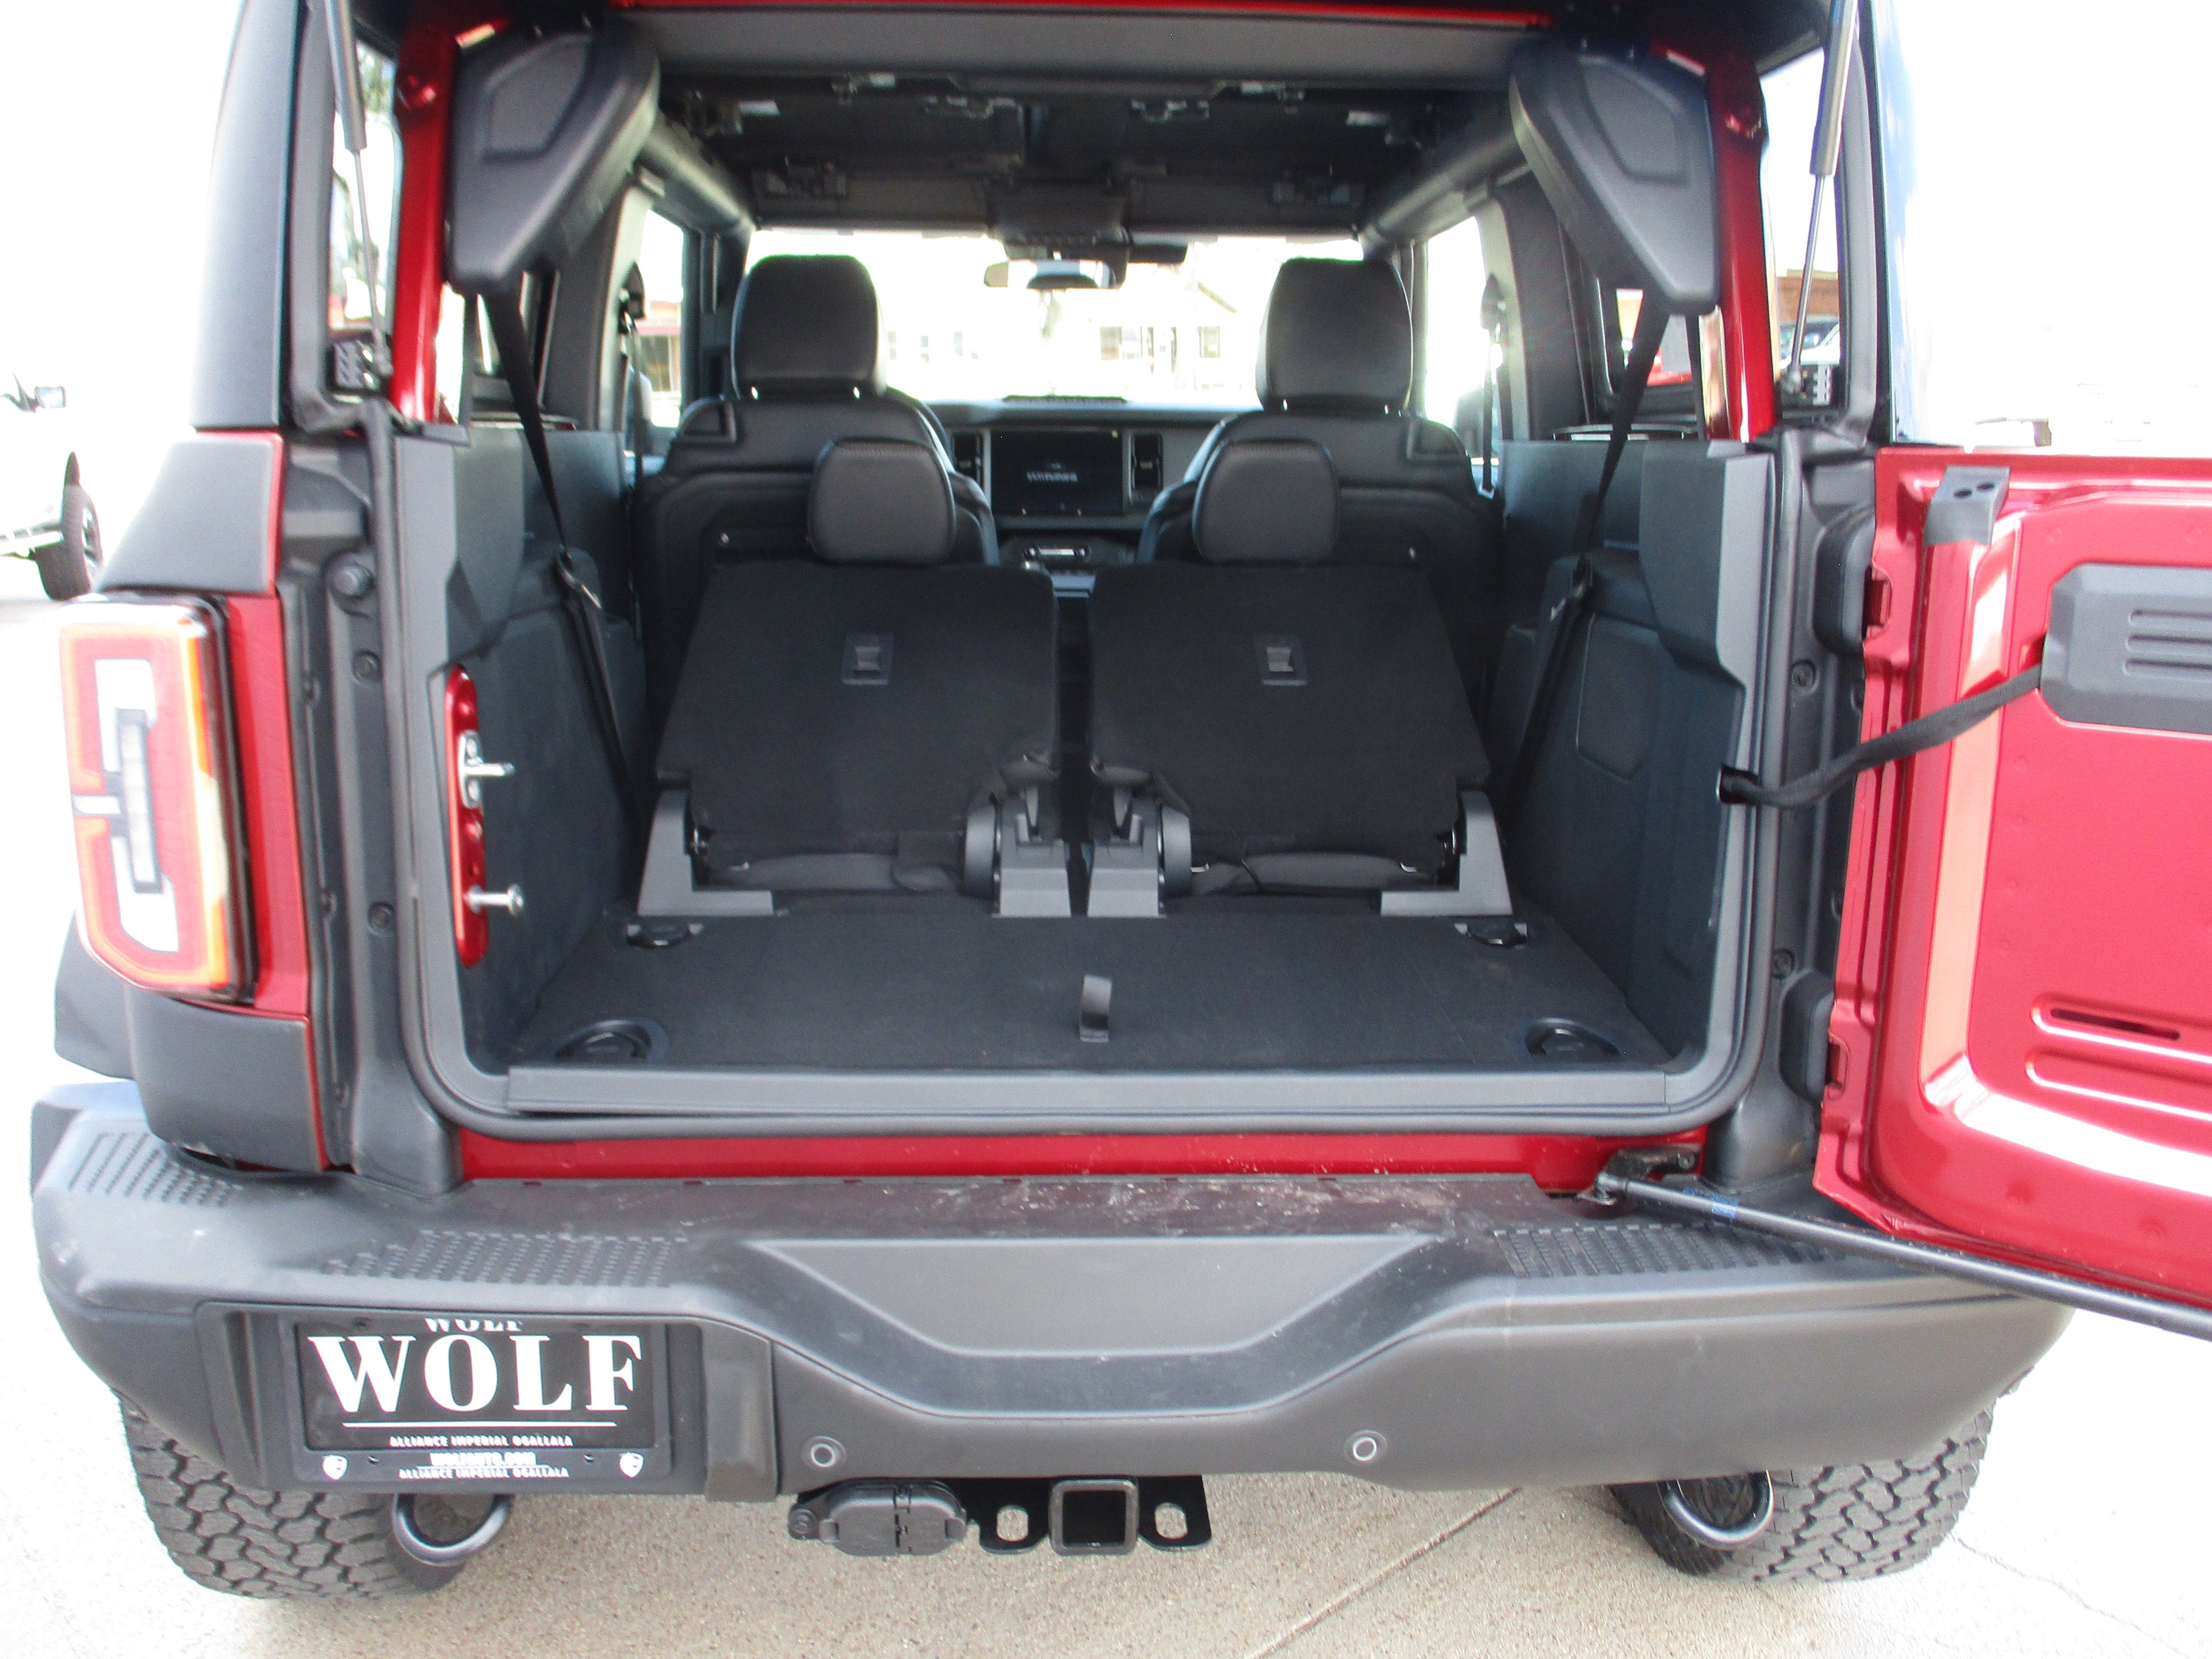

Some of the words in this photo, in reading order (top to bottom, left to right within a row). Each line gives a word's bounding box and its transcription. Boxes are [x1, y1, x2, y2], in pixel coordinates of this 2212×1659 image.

[307, 1334, 642, 1413] WOLF
[389, 1435, 449, 1447] ALLIANCE
[450, 1435, 510, 1447] IMPERIAL
[512, 1435, 574, 1447] OGALLALA
[398, 1468, 454, 1479] ALLIANCE
[455, 1468, 510, 1479] IMPERIAL
[512, 1467, 570, 1479] OGALLALA
